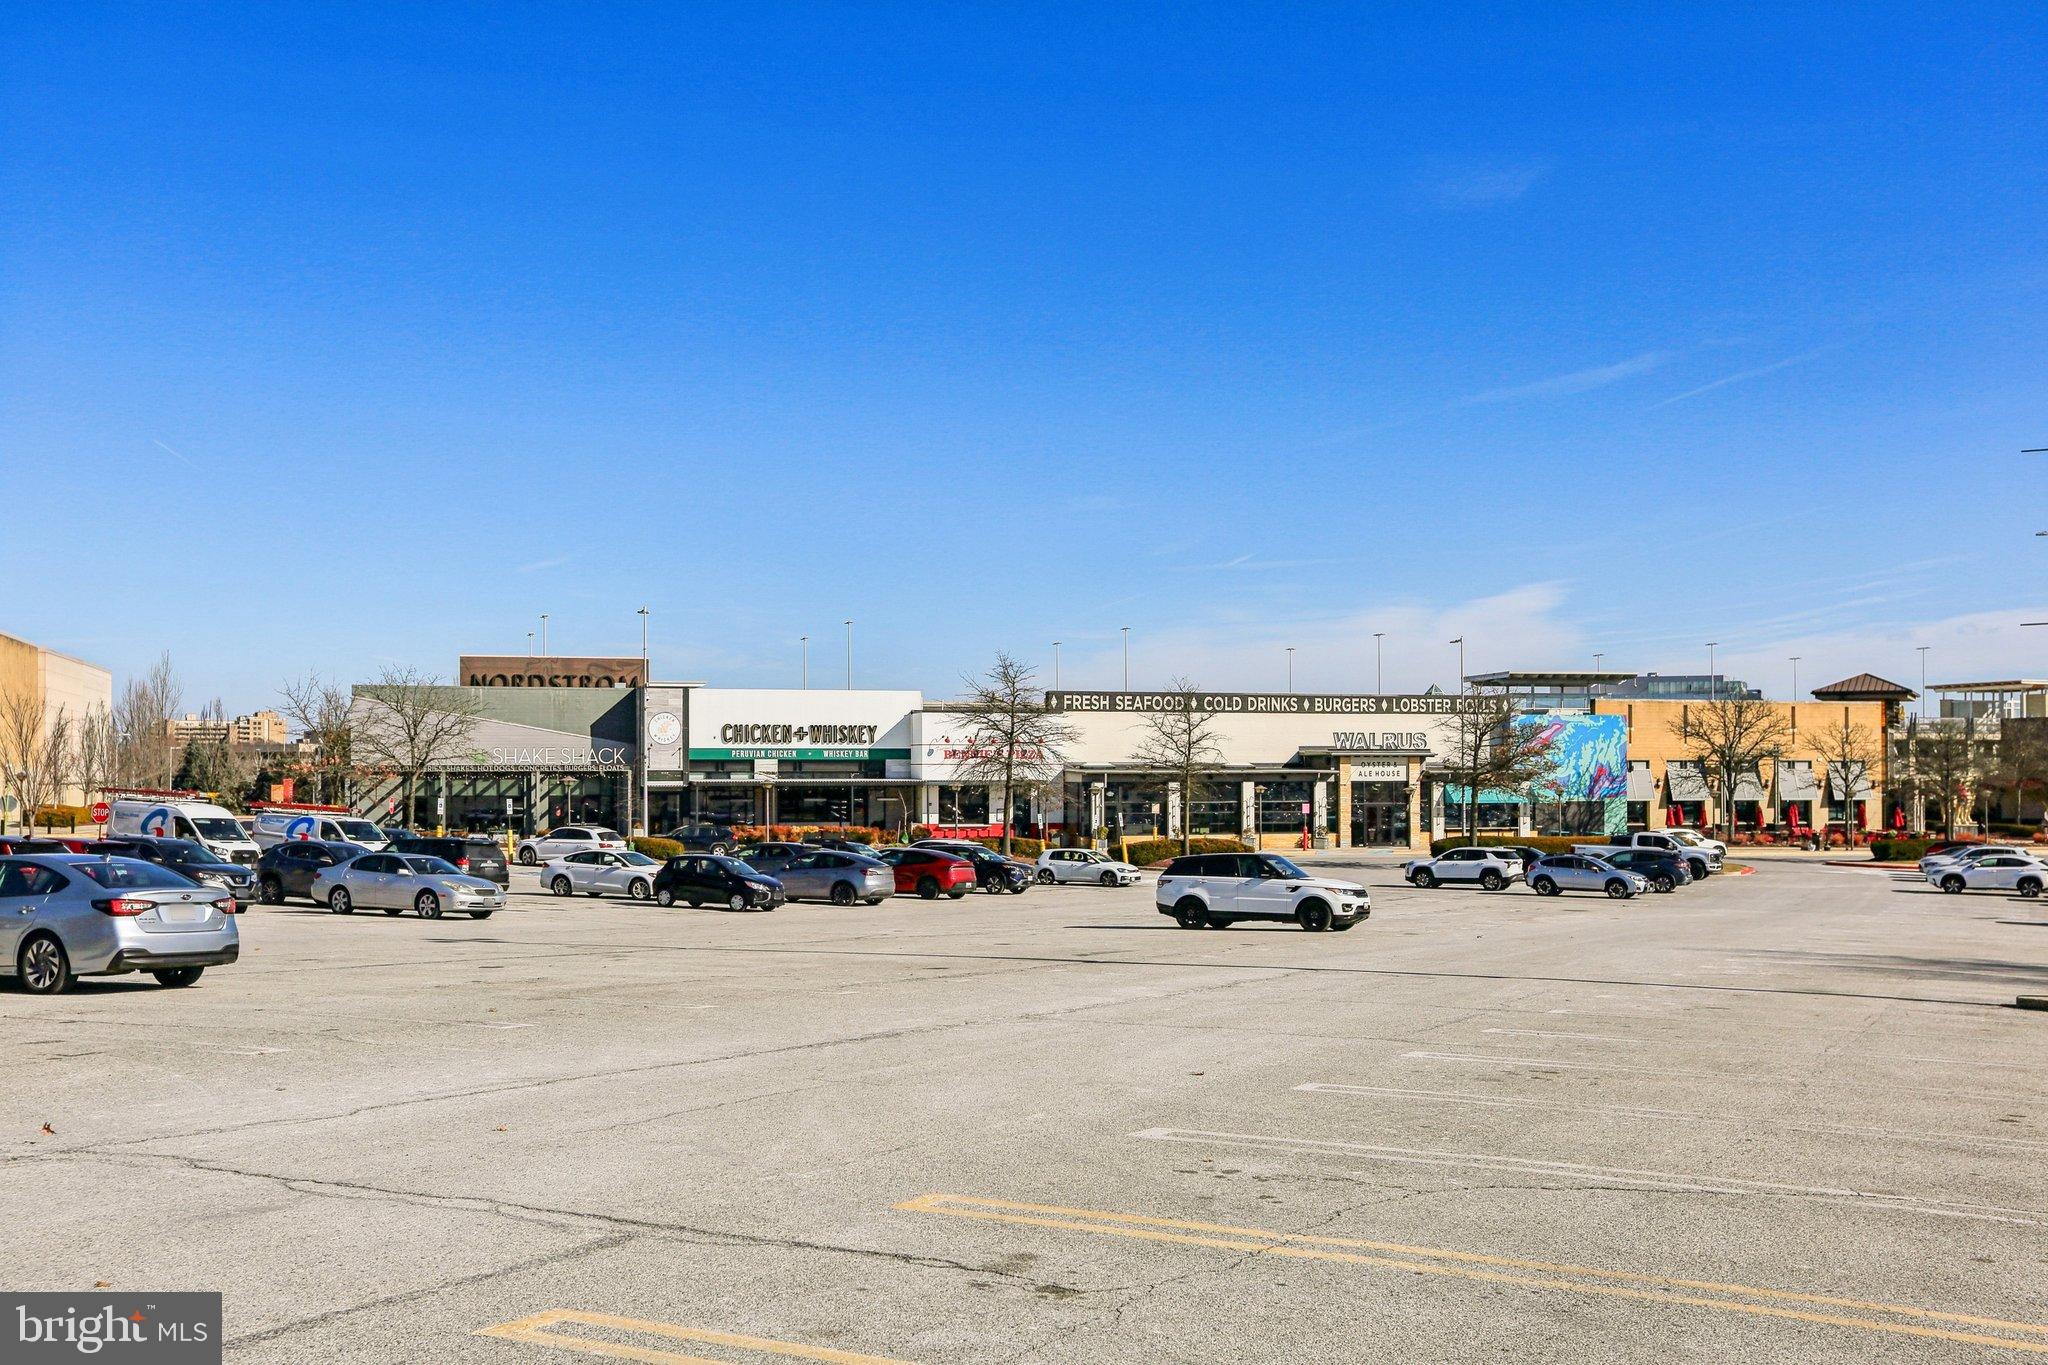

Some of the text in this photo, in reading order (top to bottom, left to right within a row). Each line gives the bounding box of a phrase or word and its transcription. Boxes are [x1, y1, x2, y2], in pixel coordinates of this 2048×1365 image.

[1063, 695, 1185, 711] FRESH SEAFOOD
[1203, 696, 1298, 712] COLD DRINKS
[1314, 698, 1377, 712] BURGERS
[1392, 698, 1451, 713] LOBSTER
[1333, 732, 1427, 750] WALRUS
[493, 747, 626, 765] SHAKE SHACK
[731, 750, 797, 758] PERUVIAN CHICKEN
[823, 750, 869, 758] WHISKEY BAR
[93, 808, 110, 817] STOP
